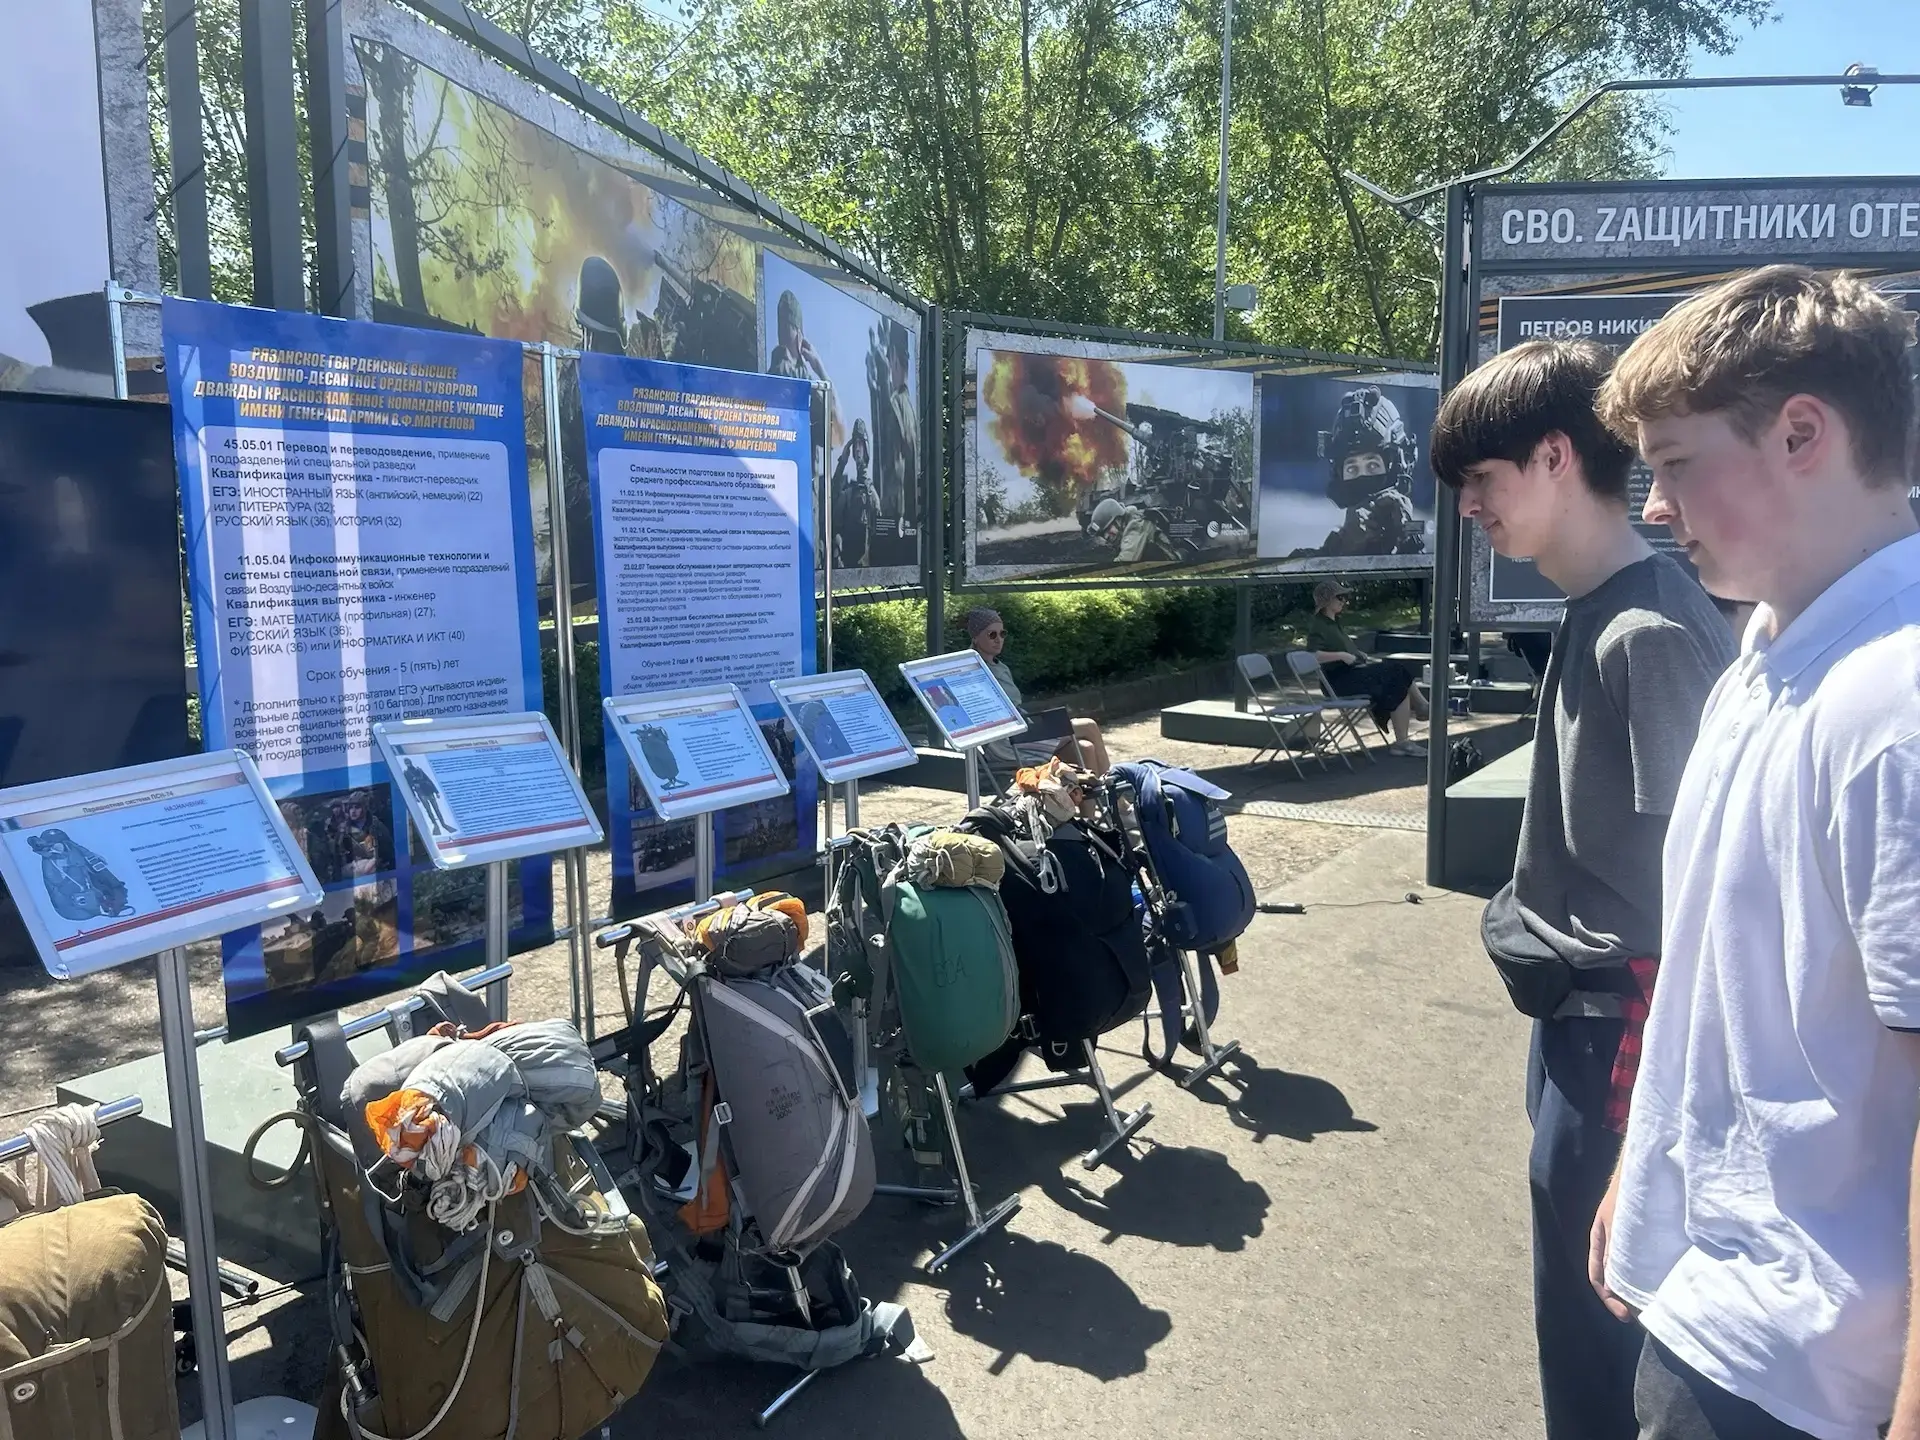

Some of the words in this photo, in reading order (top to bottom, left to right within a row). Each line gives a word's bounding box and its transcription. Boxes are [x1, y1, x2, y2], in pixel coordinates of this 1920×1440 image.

[1501, 208, 1583, 244] СВО.
[1520, 320, 1593, 336] ПЕТРОВ
[252, 347, 325, 367] РЯЗАНСКОЕ
[328, 354, 408, 375] ГВАРДЕЙСКОЕ
[411, 364, 457, 379] ВЫСШЕЕ
[229, 363, 376, 389] ВОЗДУШНО-ДЕСАНТНОЕ
[380, 377, 422, 392] ОРДЕНА
[425, 381, 478, 397] СУВОРОВА
[193, 381, 262, 400] ДВАЖДЫ
[265, 386, 384, 408] КРАСНОЗНАМЕННОЕ
[388, 396, 454, 413] КОМАНДНОЕ
[457, 401, 504, 418] УЧИЛИЩЕ
[633, 387, 680, 402] РЯЗАНСКОЕ
[681, 393, 734, 408] ГВАРДЕЙСКОЕ
[240, 402, 284, 418] ИМЕНИ
[288, 406, 347, 423] ГЕНЕРАЛА
[349, 411, 389, 425] АРМИИ
[618, 400, 712, 419] ВОЗДУШНО-ДЕСАНТНОЕ
[714, 410, 742, 422] ОРДЕНА
[743, 413, 779, 425] СУВОРОВА
[596, 414, 638, 428] ДВАЖДЫ
[640, 418, 717, 435] КРАСНОЗНАМЕННОЕ
[719, 425, 763, 438] КОМАНДНОЕ
[764, 429, 797, 442] УЧИЛИЩЕ
[224, 439, 272, 451] 45.05.01
[277, 441, 328, 454] Перевод
[340, 445, 435, 459] переводоведение,
[438, 451, 490, 460] применение
[624, 430, 653, 442] ИМЕНИ
[654, 432, 692, 446] ГЕНЕРАЛА
[694, 436, 720, 448] АРМИИ
[210, 455, 300, 467] подразделений
[304, 458, 370, 468] специальной
[373, 462, 416, 471] разведки
[630, 464, 686, 475] Специальности
[689, 469, 726, 477] подготовки
[736, 472, 775, 480] программам
[212, 468, 304, 481] Квалификация
[308, 473, 373, 482] выпускника
[382, 474, 478, 485] лингвист-переводчик
[630, 476, 664, 484] среднего
[665, 478, 733, 488] профессионального
[735, 481, 775, 490] образования
[213, 486, 241, 497] ЕГЭ:
[244, 486, 333, 498] ИНОСТРАННЫЙ
[336, 488, 363, 499] ЯЗЫК
[366, 490, 420, 502] (английский,
[423, 490, 467, 502] немецкий)
[468, 491, 483, 502] (22)
[214, 503, 235, 511] или
[238, 501, 312, 512] ЛИТЕРАТУРА
[315, 503, 335, 514] (32);
[215, 514, 273, 526] РУССКИЙ
[276, 516, 309, 526] ЯЗЫК
[311, 516, 332, 528] (36);
[335, 516, 382, 526] ИСТОРИЯ
[385, 516, 402, 528] (32)
[238, 555, 285, 566] 11.05.04
[289, 554, 425, 563] Инфокоммуникационные
[429, 552, 481, 561] технологии
[224, 570, 280, 580] системы
[284, 567, 358, 579] специальной
[397, 566, 450, 576] применение
[452, 562, 510, 574] подразделений
[225, 585, 256, 595] связи
[260, 581, 366, 595] Воздушно-десантных
[369, 580, 394, 589] войск
[226, 596, 318, 610] Квалификация
[322, 595, 385, 604] выпускника
[395, 592, 436, 601] инженер
[228, 617, 258, 628] ЕГЭ:
[261, 612, 341, 626] МАТЕМАТИКА
[344, 610, 412, 623] (профильная)
[414, 607, 436, 619] (27);
[229, 626, 290, 642] РУССКИЙ
[293, 626, 326, 638] ЯЗЫК
[329, 625, 352, 638] (36);
[230, 644, 283, 656] ФИЗИКА
[286, 642, 308, 656] (36)
[311, 642, 331, 651] или
[333, 637, 414, 647] ИНФОРМАТИКА
[416, 632, 424, 643] И
[427, 632, 446, 642] ИКТ
[449, 630, 465, 642] (40)
[306, 669, 336, 682] Срок
[339, 666, 390, 679] обучения
[401, 661, 407, 673] 5
[410, 659, 441, 674] (пять)
[443, 659, 460, 669] лет
[243, 696, 328, 713] Дополнительно
[338, 689, 396, 700] результатам
[398, 686, 418, 696] ЕГЭ
[420, 678, 475, 695] учитываются
[234, 713, 289, 727] дуальные
[292, 705, 352, 721] достижения
[355, 702, 370, 714] (до
[373, 701, 384, 710] 10
[428, 694, 445, 705] Для
[446, 689, 497, 702] поступления
[235, 725, 284, 739] военные
[287, 717, 363, 733] специальности
[366, 712, 392, 723] связи
[395, 711, 400, 719] и
[403, 704, 462, 719] специального
[464, 698, 509, 710] назначения
[236, 737, 292, 752] требуется
[295, 727, 361, 744] оформление
[266, 743, 355, 762] государственную
